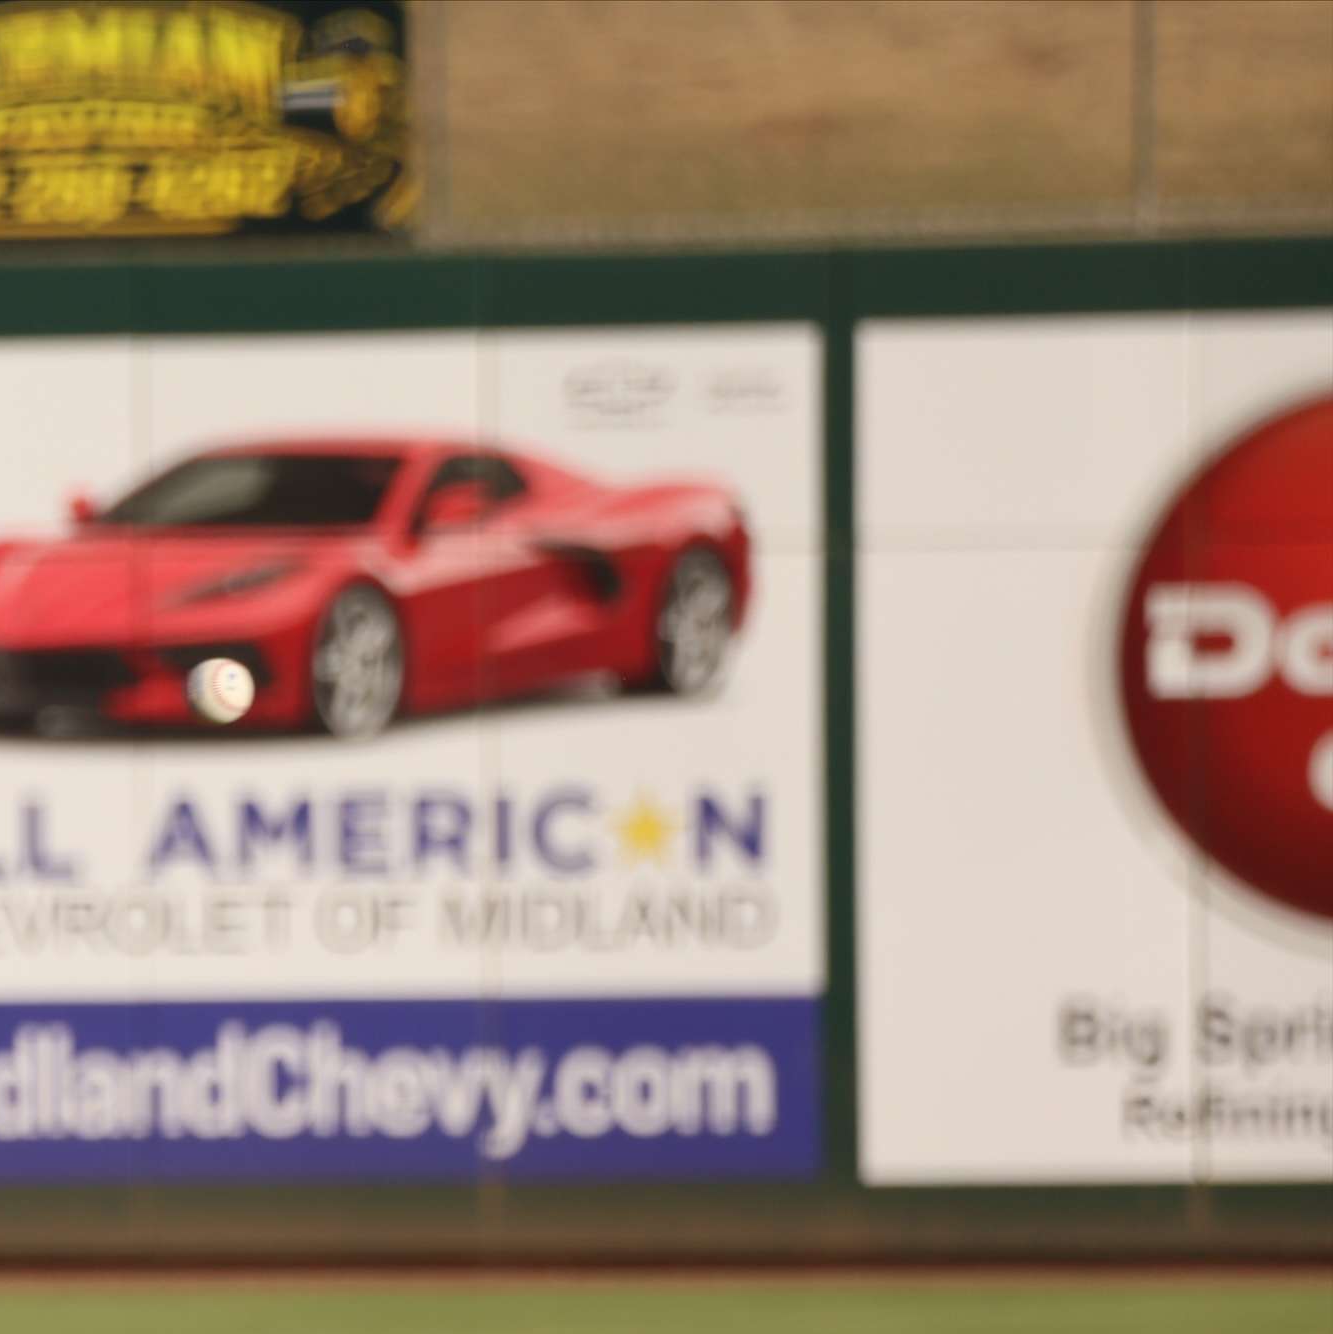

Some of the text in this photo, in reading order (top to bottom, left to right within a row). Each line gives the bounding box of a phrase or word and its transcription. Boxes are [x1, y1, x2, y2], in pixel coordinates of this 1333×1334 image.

[314, 886, 417, 956] OF
[443, 883, 780, 956] MIDLAND
[1058, 996, 1169, 1084] Big
